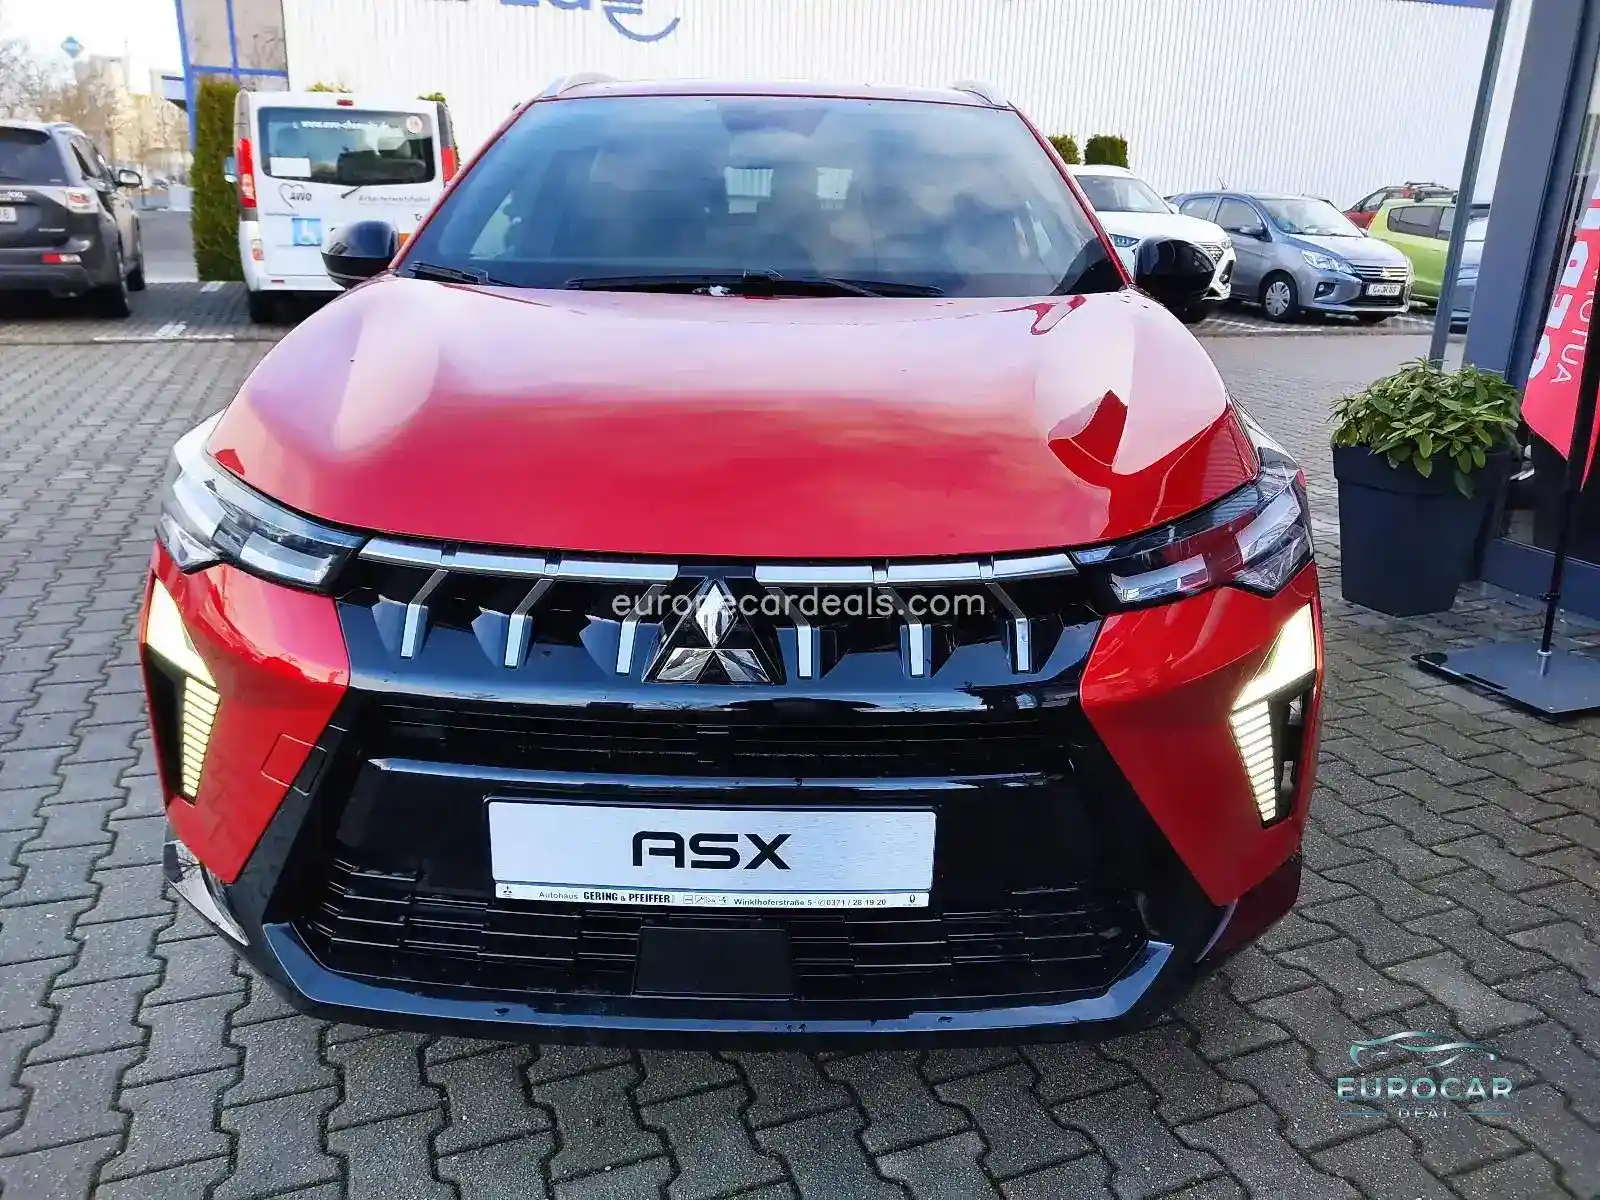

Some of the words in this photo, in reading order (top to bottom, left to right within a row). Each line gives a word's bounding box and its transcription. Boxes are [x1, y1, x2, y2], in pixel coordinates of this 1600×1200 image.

[632, 830, 792, 870] ASX
[538, 891, 579, 900] Autohaus
[583, 891, 619, 902] GERING
[628, 894, 671, 904] PFEIFFER
[733, 898, 805, 906] Winklhoferstraße
